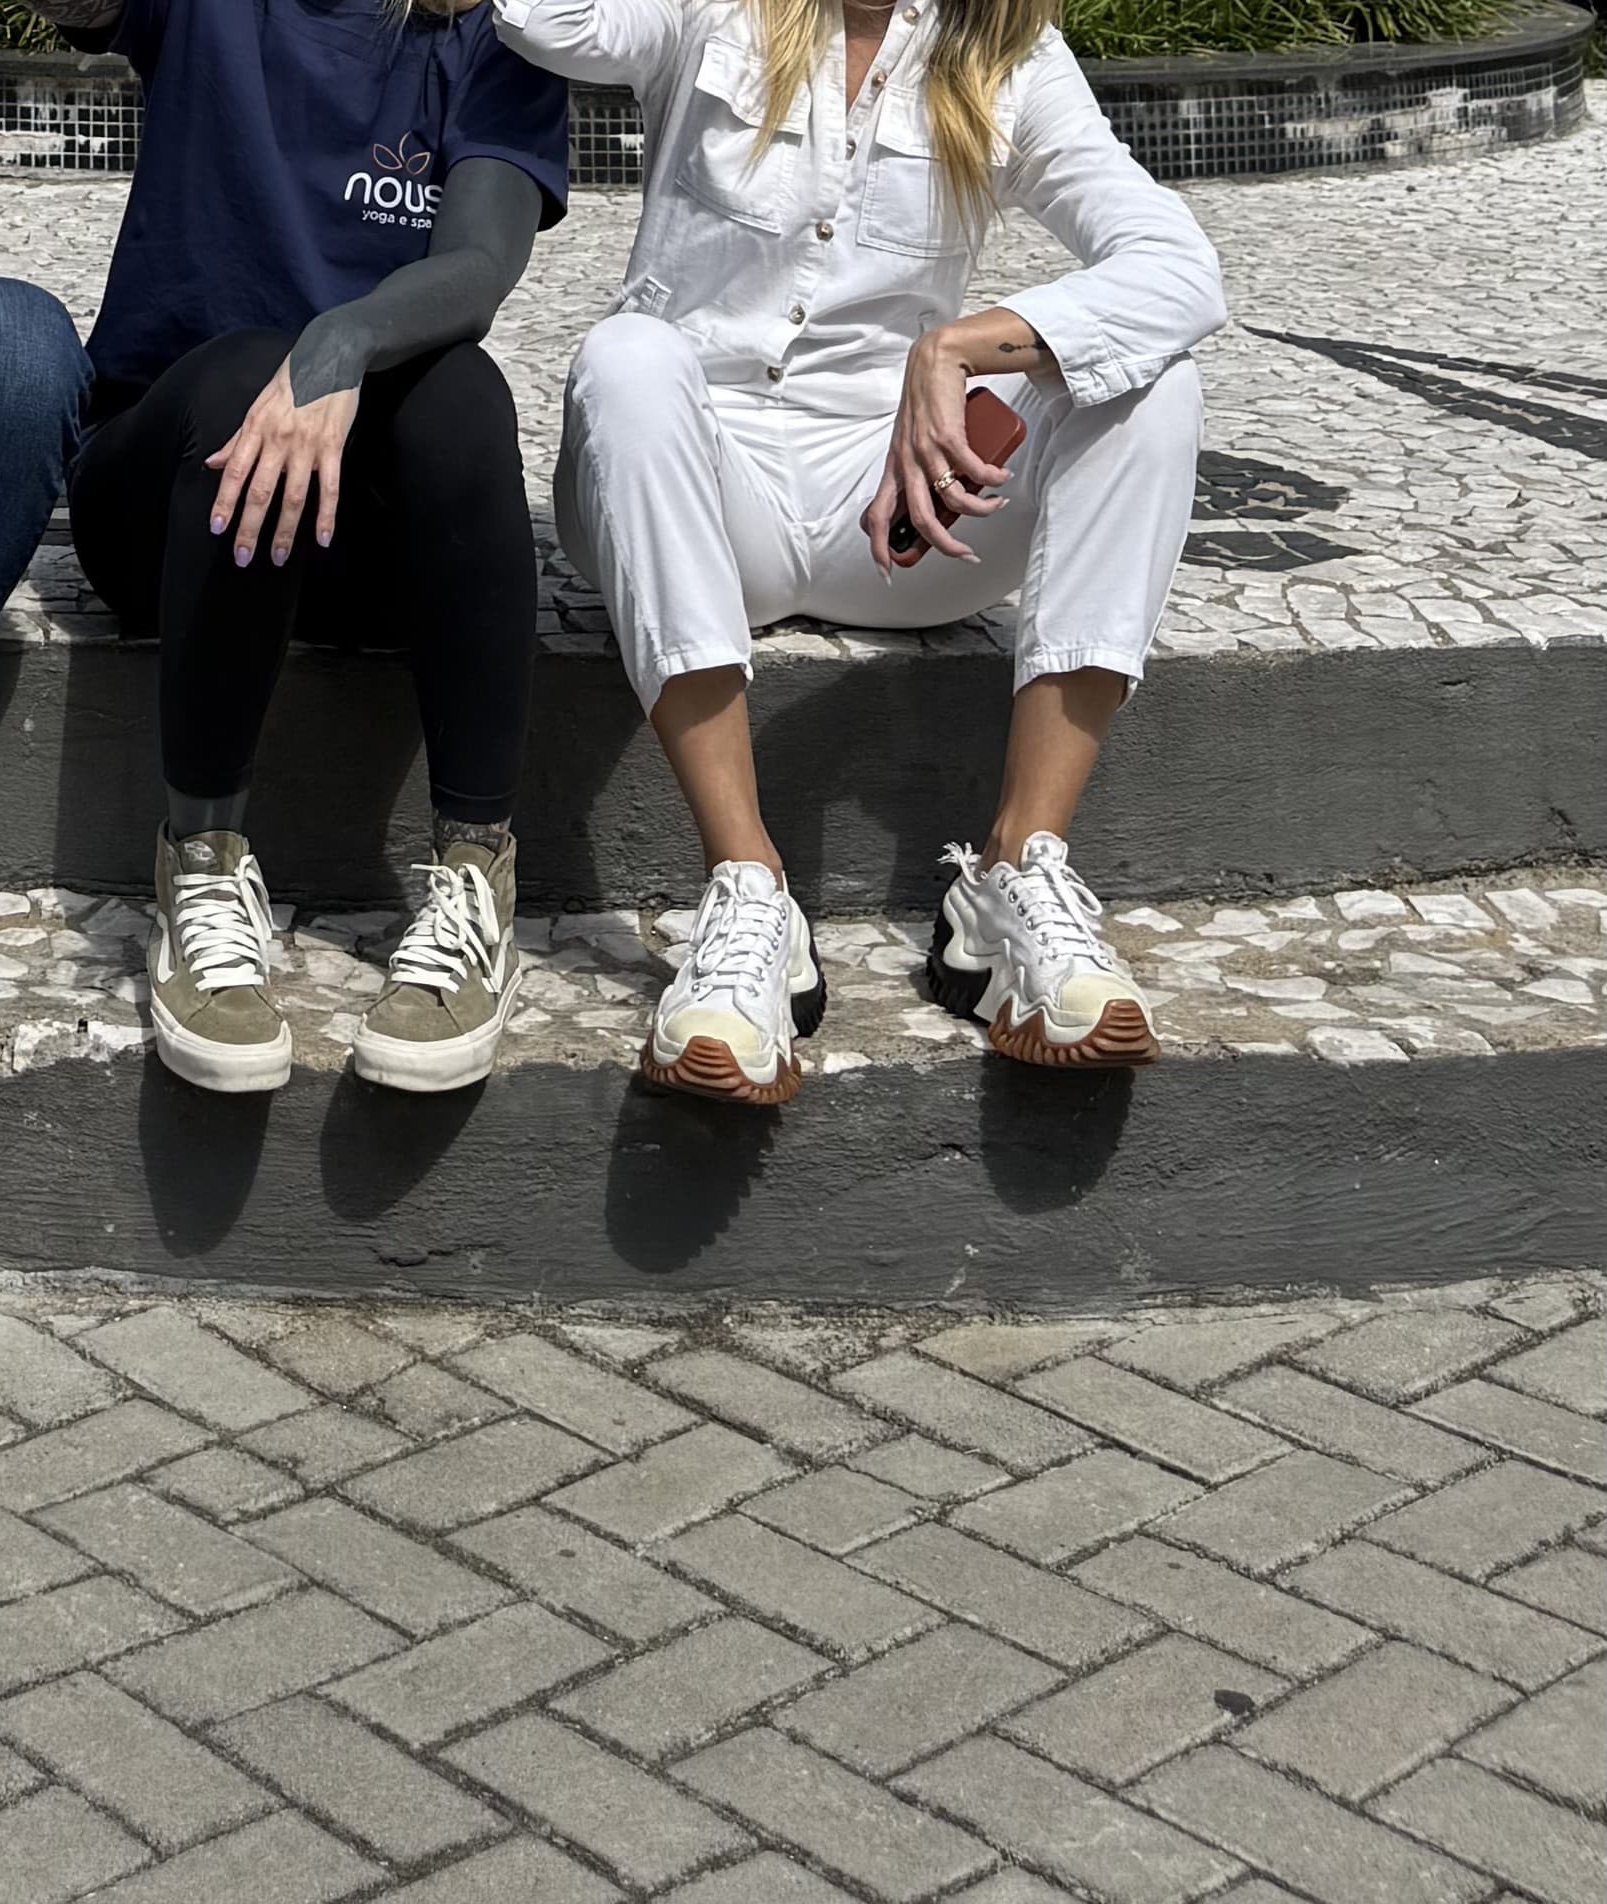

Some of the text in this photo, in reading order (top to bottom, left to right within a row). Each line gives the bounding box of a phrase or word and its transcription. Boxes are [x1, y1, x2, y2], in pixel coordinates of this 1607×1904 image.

[361, 209, 432, 230] yoga e spa
